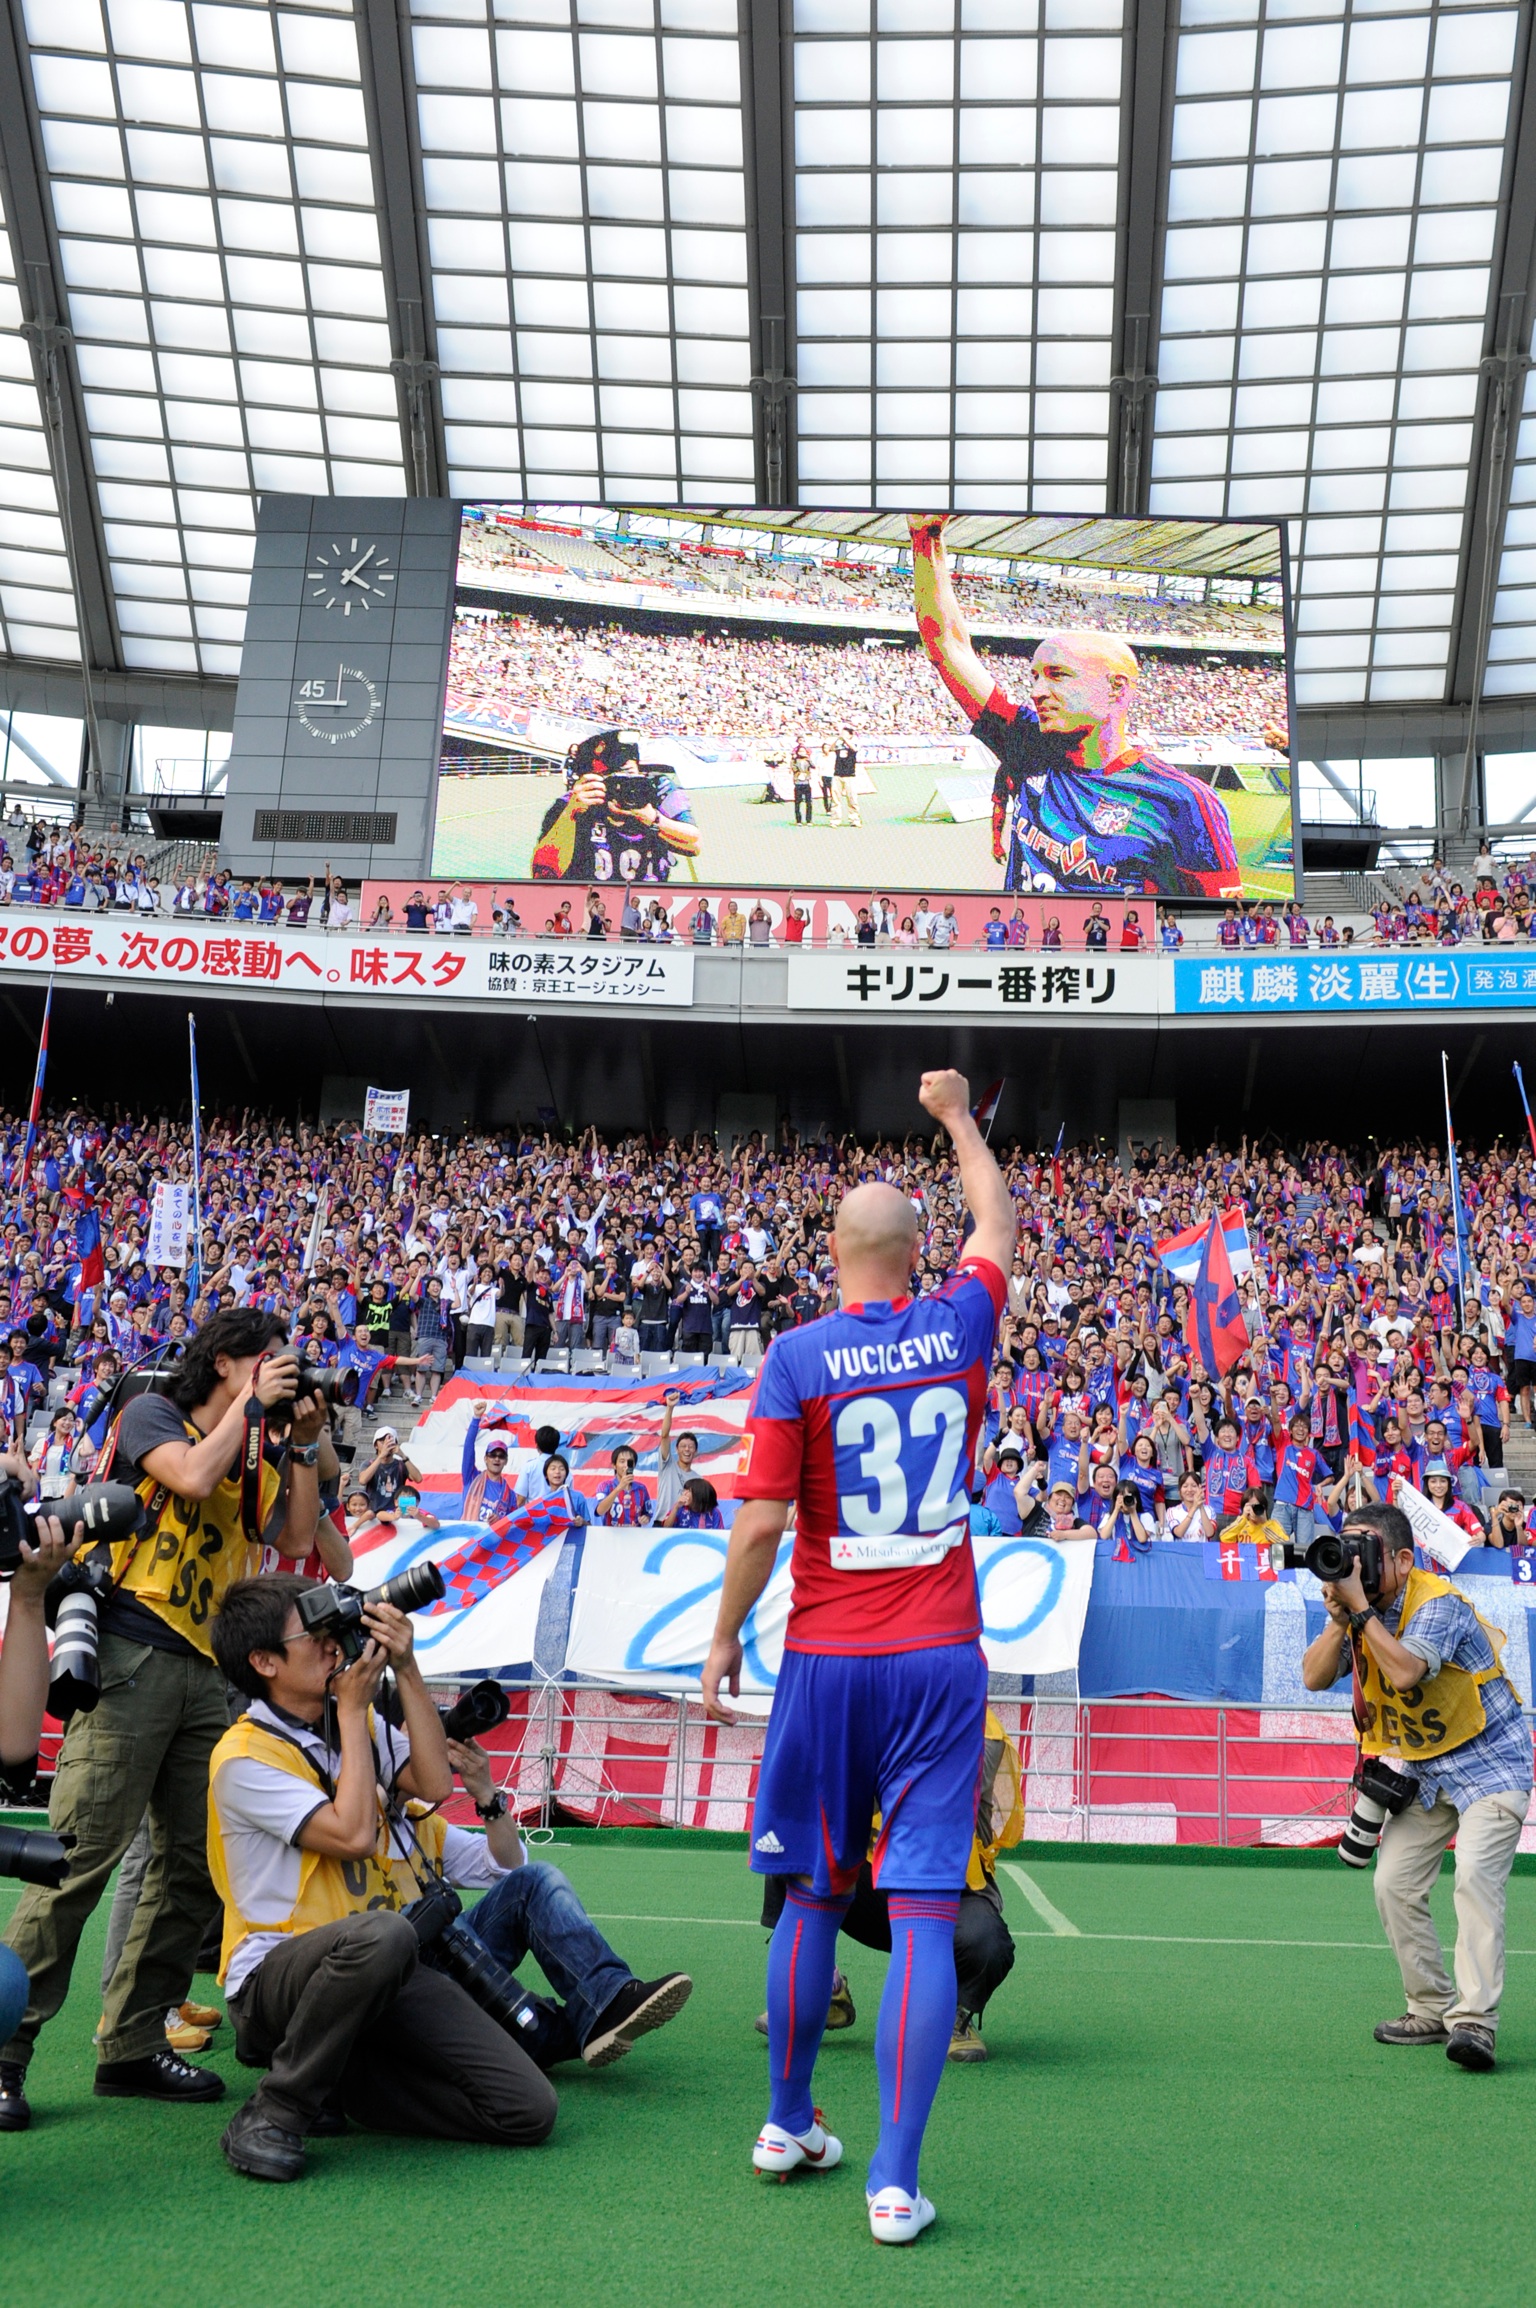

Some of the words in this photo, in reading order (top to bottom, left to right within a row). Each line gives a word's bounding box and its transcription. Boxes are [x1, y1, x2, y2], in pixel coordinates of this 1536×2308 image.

[299, 680, 326, 698] 45
[0, 926, 467, 987] の夢、次の感動へ。味スタ
[489, 952, 666, 979] 味の素スタジアム
[847, 964, 1116, 1004] キリン一番搾り
[368, 1089, 403, 1101] Bravo
[172, 1187, 184, 1242] 全ての心を
[824, 1331, 959, 1380] VUCICEVIC
[246, 1426, 260, 1470] Canon
[836, 1386, 971, 1536] 32
[1518, 1559, 1532, 1581] 3
